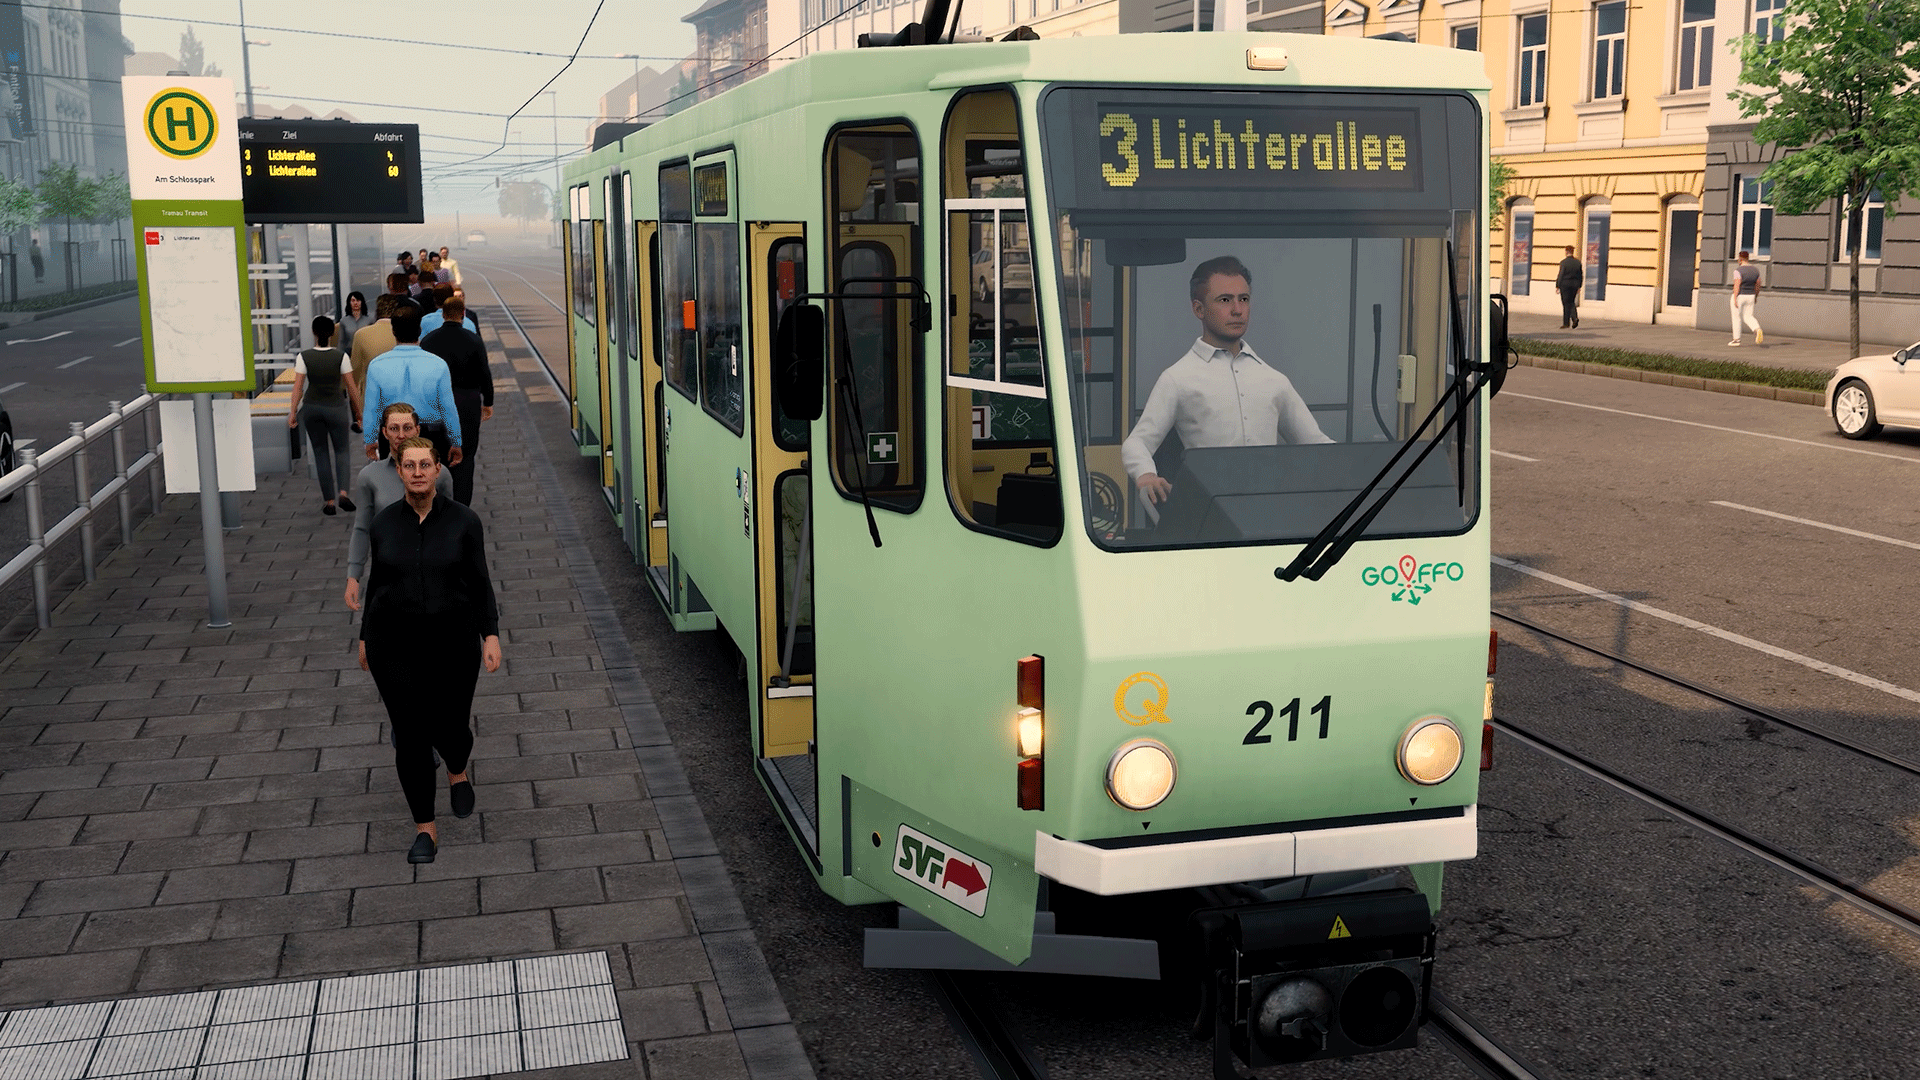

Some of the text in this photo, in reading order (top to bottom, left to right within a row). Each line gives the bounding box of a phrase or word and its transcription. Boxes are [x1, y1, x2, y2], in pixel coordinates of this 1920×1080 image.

[165, 106, 197, 142] H
[239, 130, 404, 142] inie Ziel Abfahrt
[244, 148, 251, 161] 3
[267, 149, 317, 161] Lichterallee
[1099, 113, 1407, 187] 3 Lichterallee
[245, 164, 253, 177] 3
[268, 164, 318, 177] Lichterallee
[155, 175, 216, 185] Am Schlosspark
[184, 209, 209, 217] Transit
[160, 234, 164, 242] 3
[1242, 695, 1332, 745] 211
[898, 834, 946, 885] SVF
